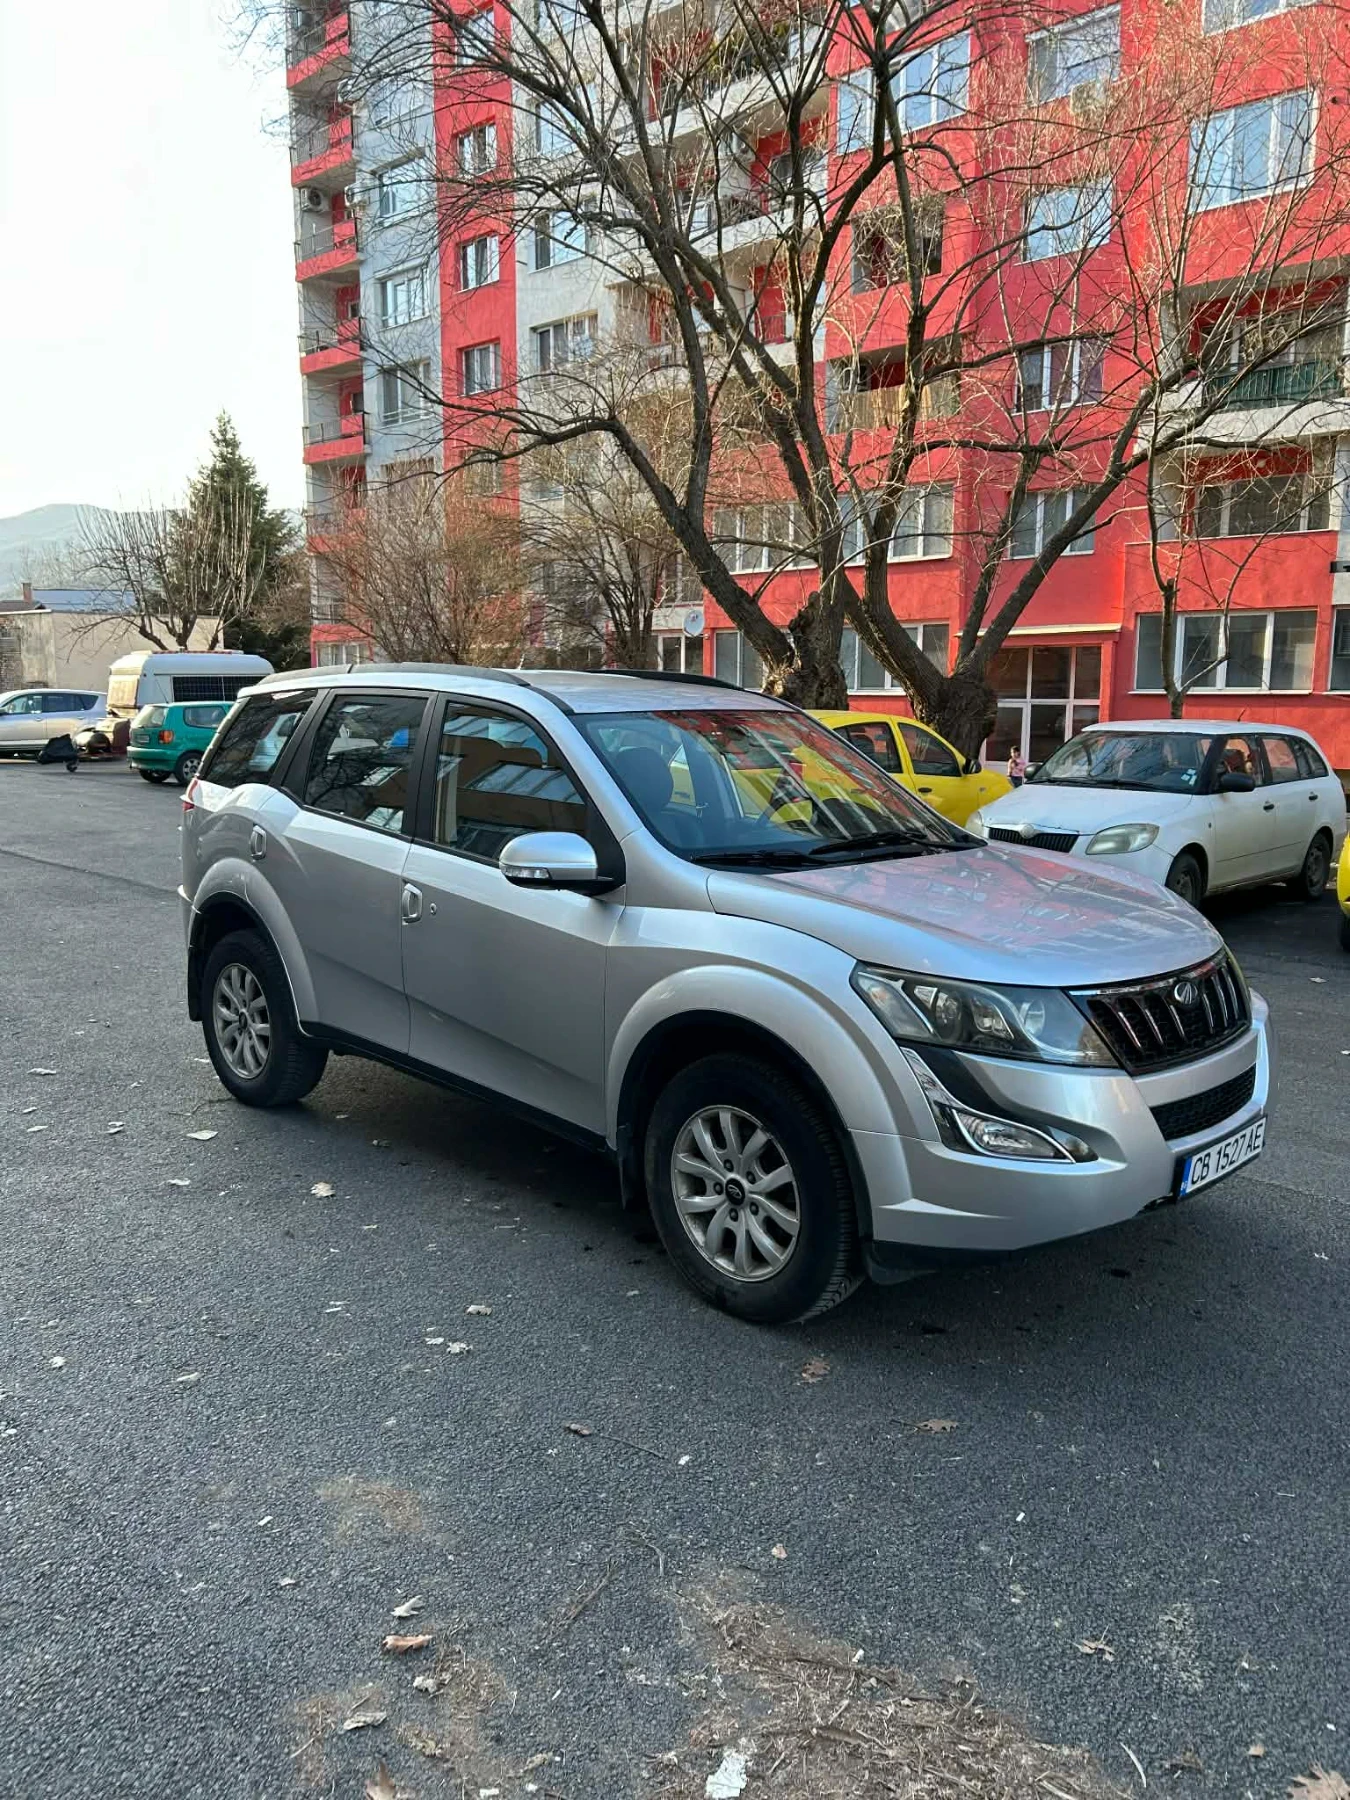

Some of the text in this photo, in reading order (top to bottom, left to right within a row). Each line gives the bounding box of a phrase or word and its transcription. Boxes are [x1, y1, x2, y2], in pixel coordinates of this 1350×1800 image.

[1191, 1123, 1263, 1185] CB 1527 AE
